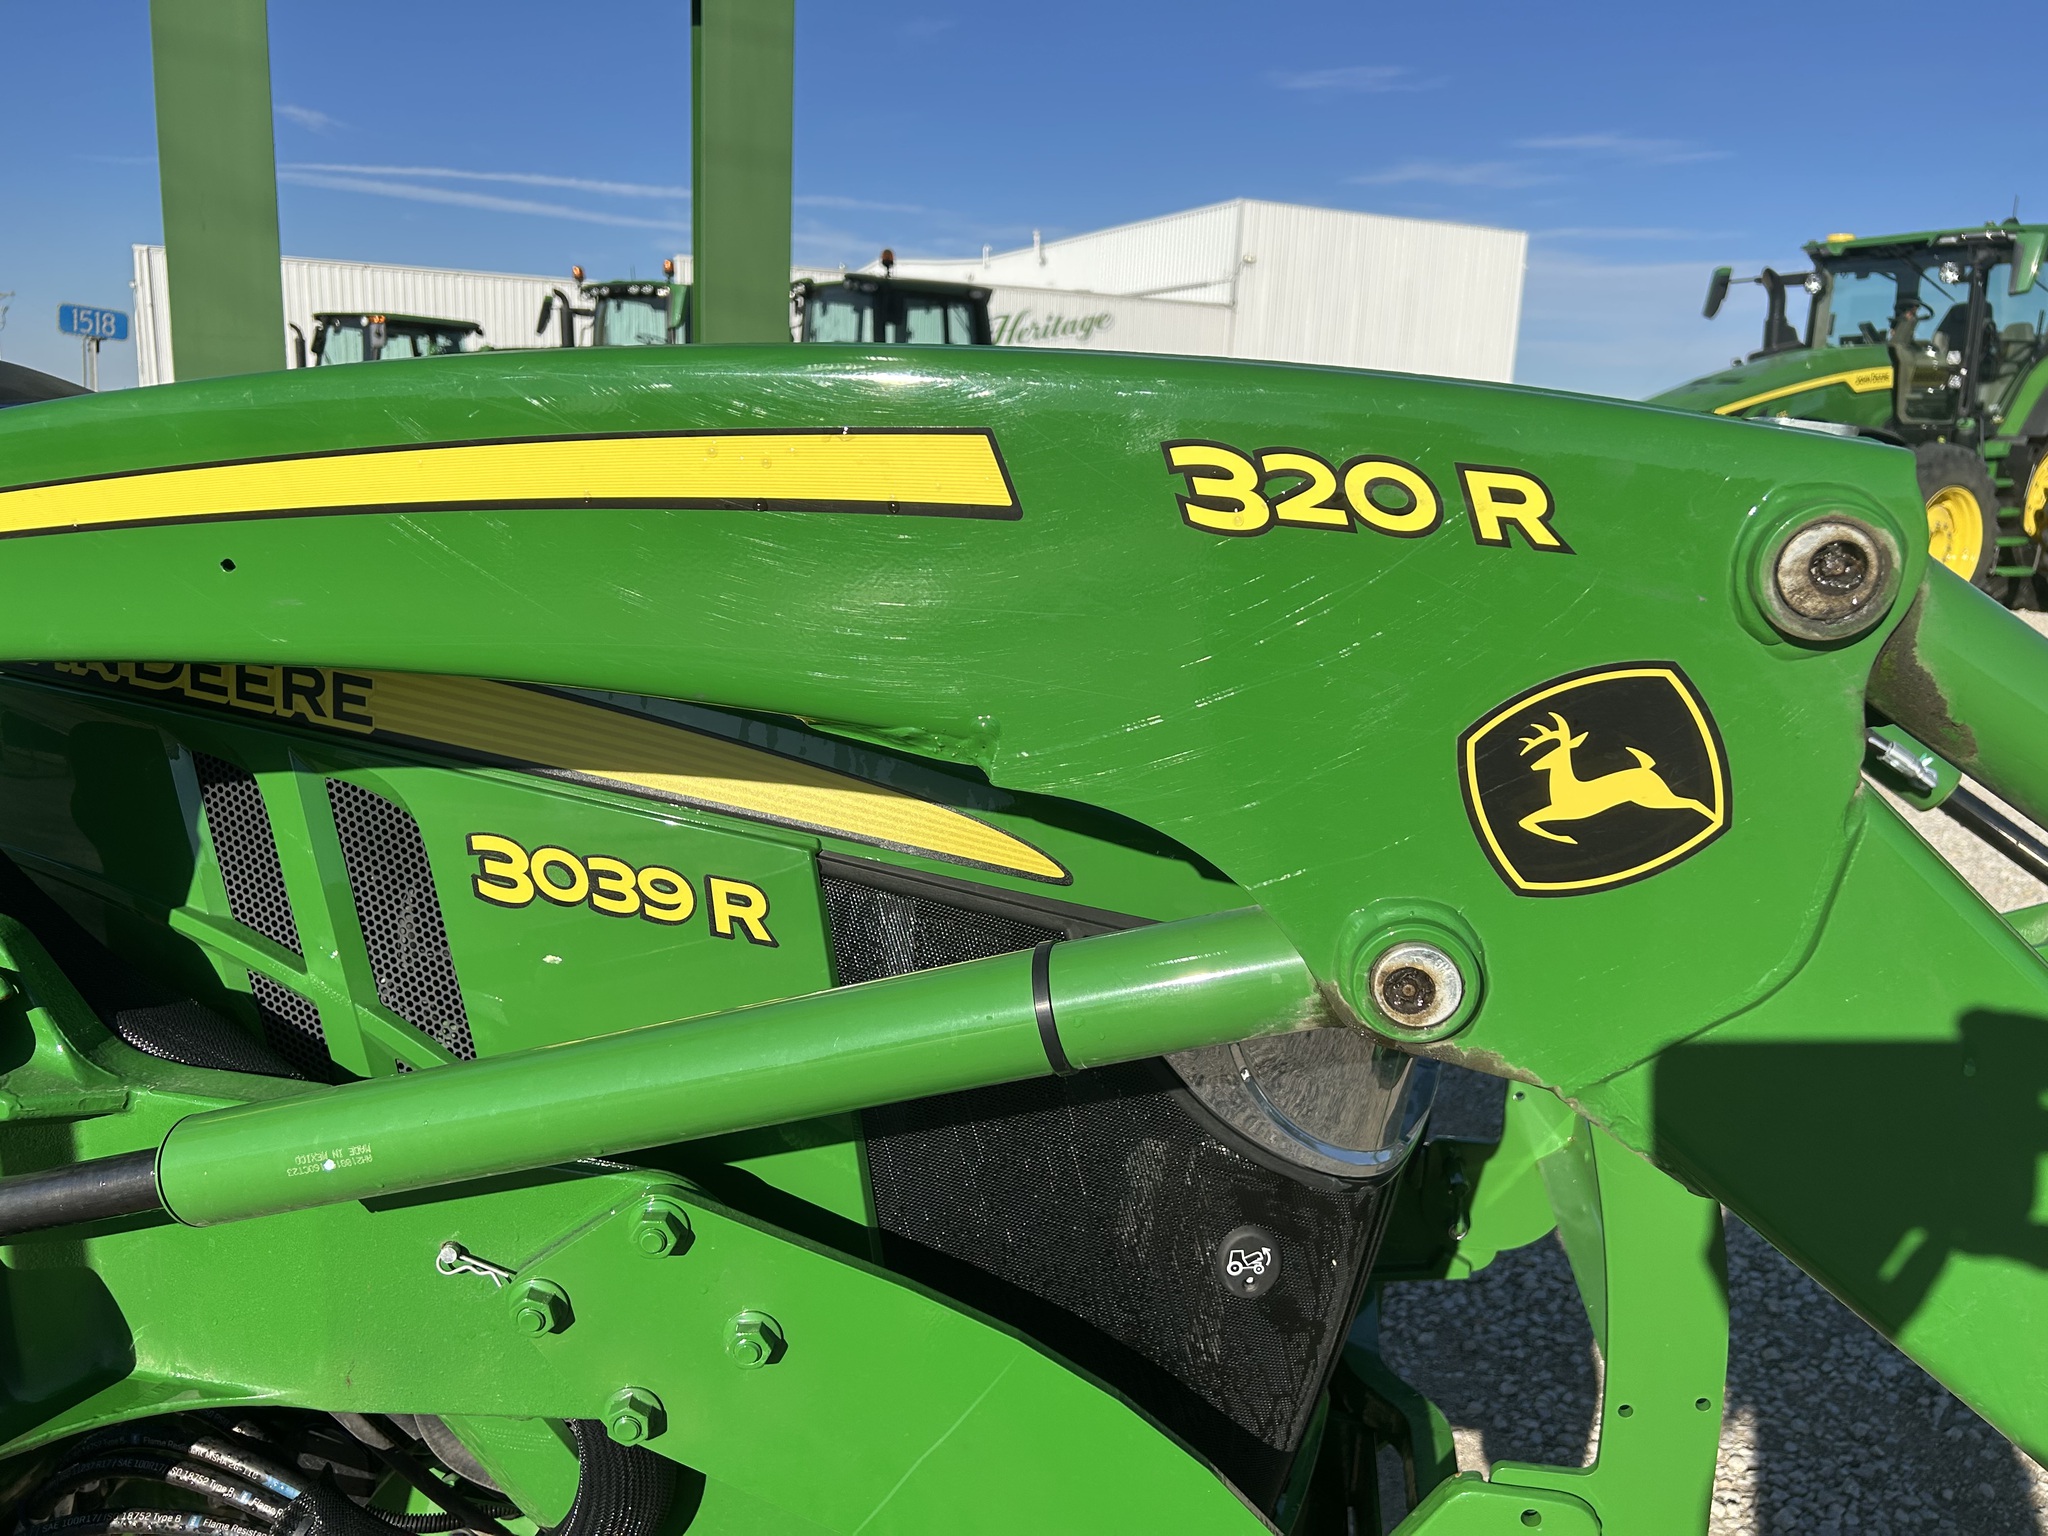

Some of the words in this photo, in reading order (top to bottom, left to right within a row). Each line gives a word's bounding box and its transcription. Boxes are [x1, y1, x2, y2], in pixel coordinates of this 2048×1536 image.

[72, 308, 116, 337] 1518
[990, 308, 1113, 347] Heritage
[1161, 439, 1444, 538] 320
[1455, 462, 1577, 555] R
[467, 833, 697, 925] 3039
[704, 875, 780, 948] R
[295, 1150, 328, 1166] MEXICO
[331, 1148, 343, 1159] IN
[348, 1143, 372, 1157] MADE
[183, 1470, 210, 1486] 18752
[209, 1479, 228, 1494] Type
[249, 1497, 277, 1516] Flame
[42, 1523, 59, 1534] SAE
[121, 1511, 151, 1521] 18752
[153, 1512, 173, 1523] Type
[174, 1513, 182, 1523] B
[202, 1518, 230, 1531] Flame
